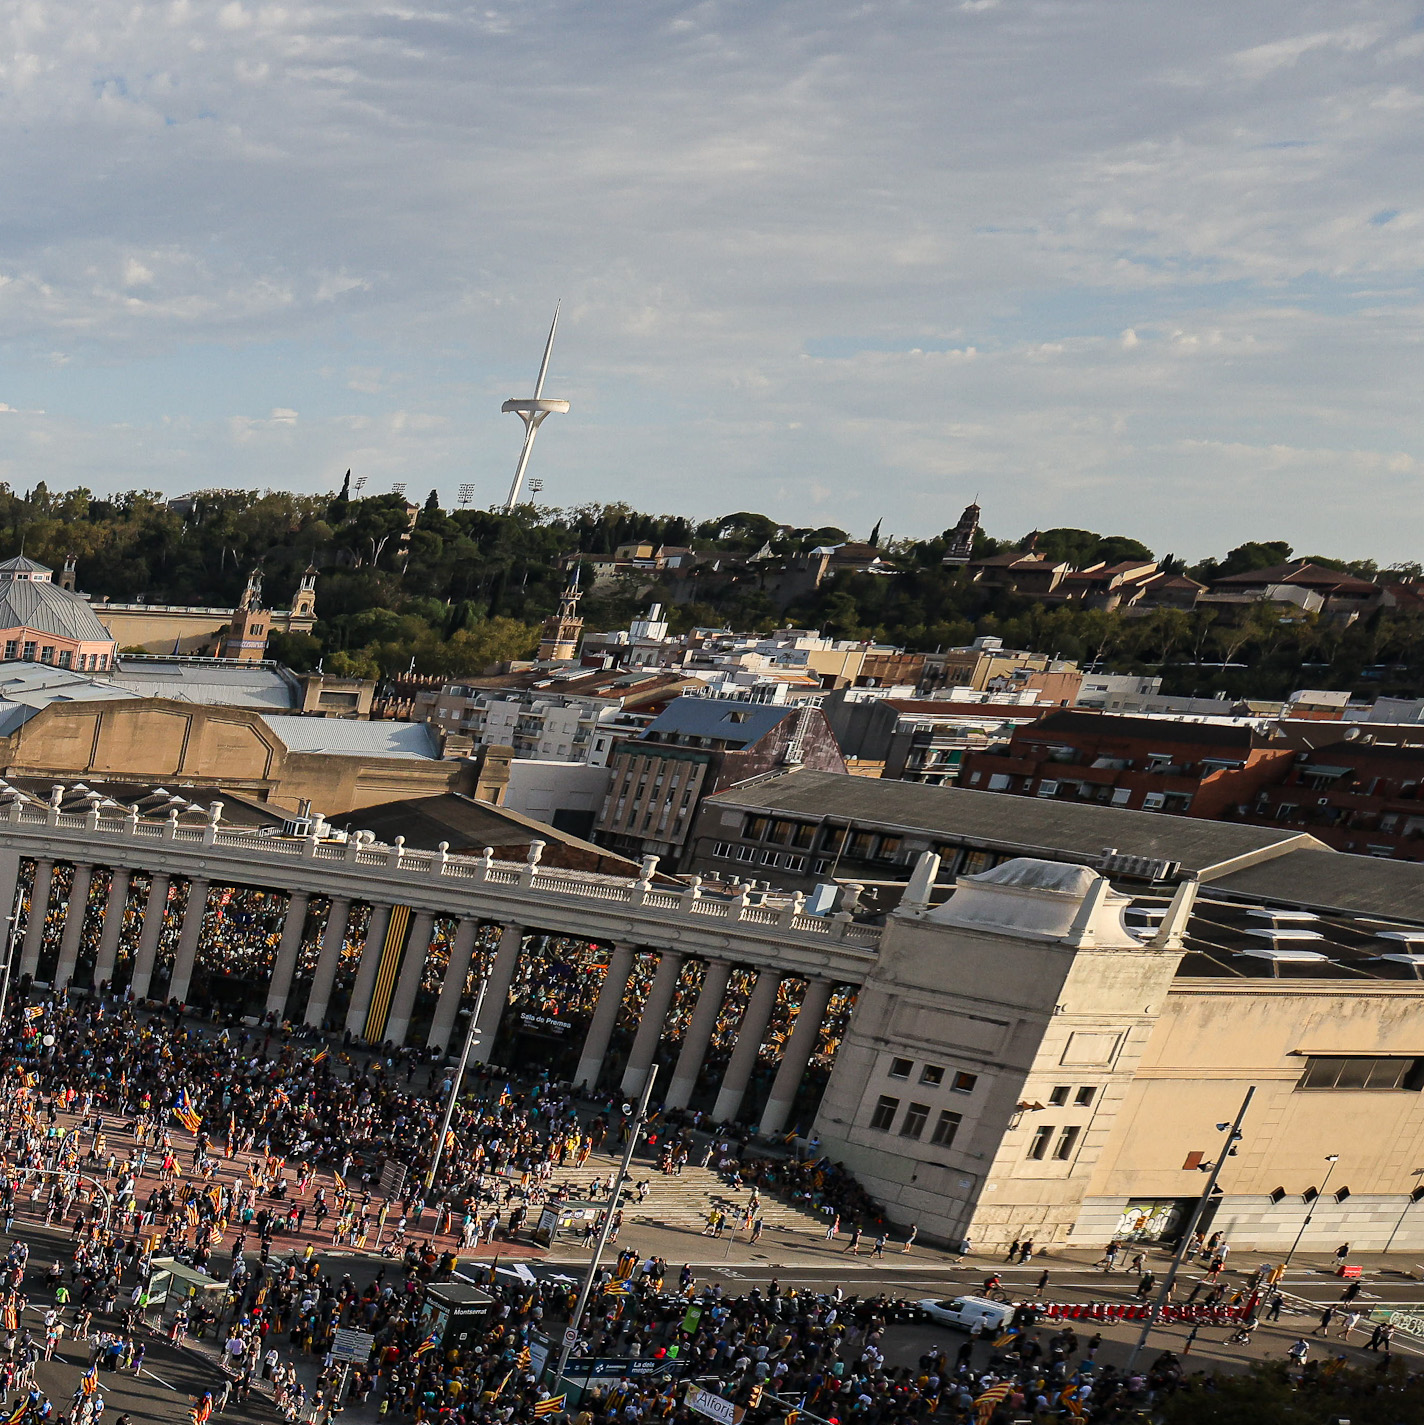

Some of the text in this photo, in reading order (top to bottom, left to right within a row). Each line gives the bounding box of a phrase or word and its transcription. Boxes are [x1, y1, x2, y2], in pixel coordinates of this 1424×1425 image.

[520, 1012, 535, 1021] Sala
[546, 1017, 572, 1028] Premsa
[426, 1296, 451, 1315] Montserrat
[454, 1307, 487, 1316] Montserrat
[696, 1391, 734, 1419] Alforja
